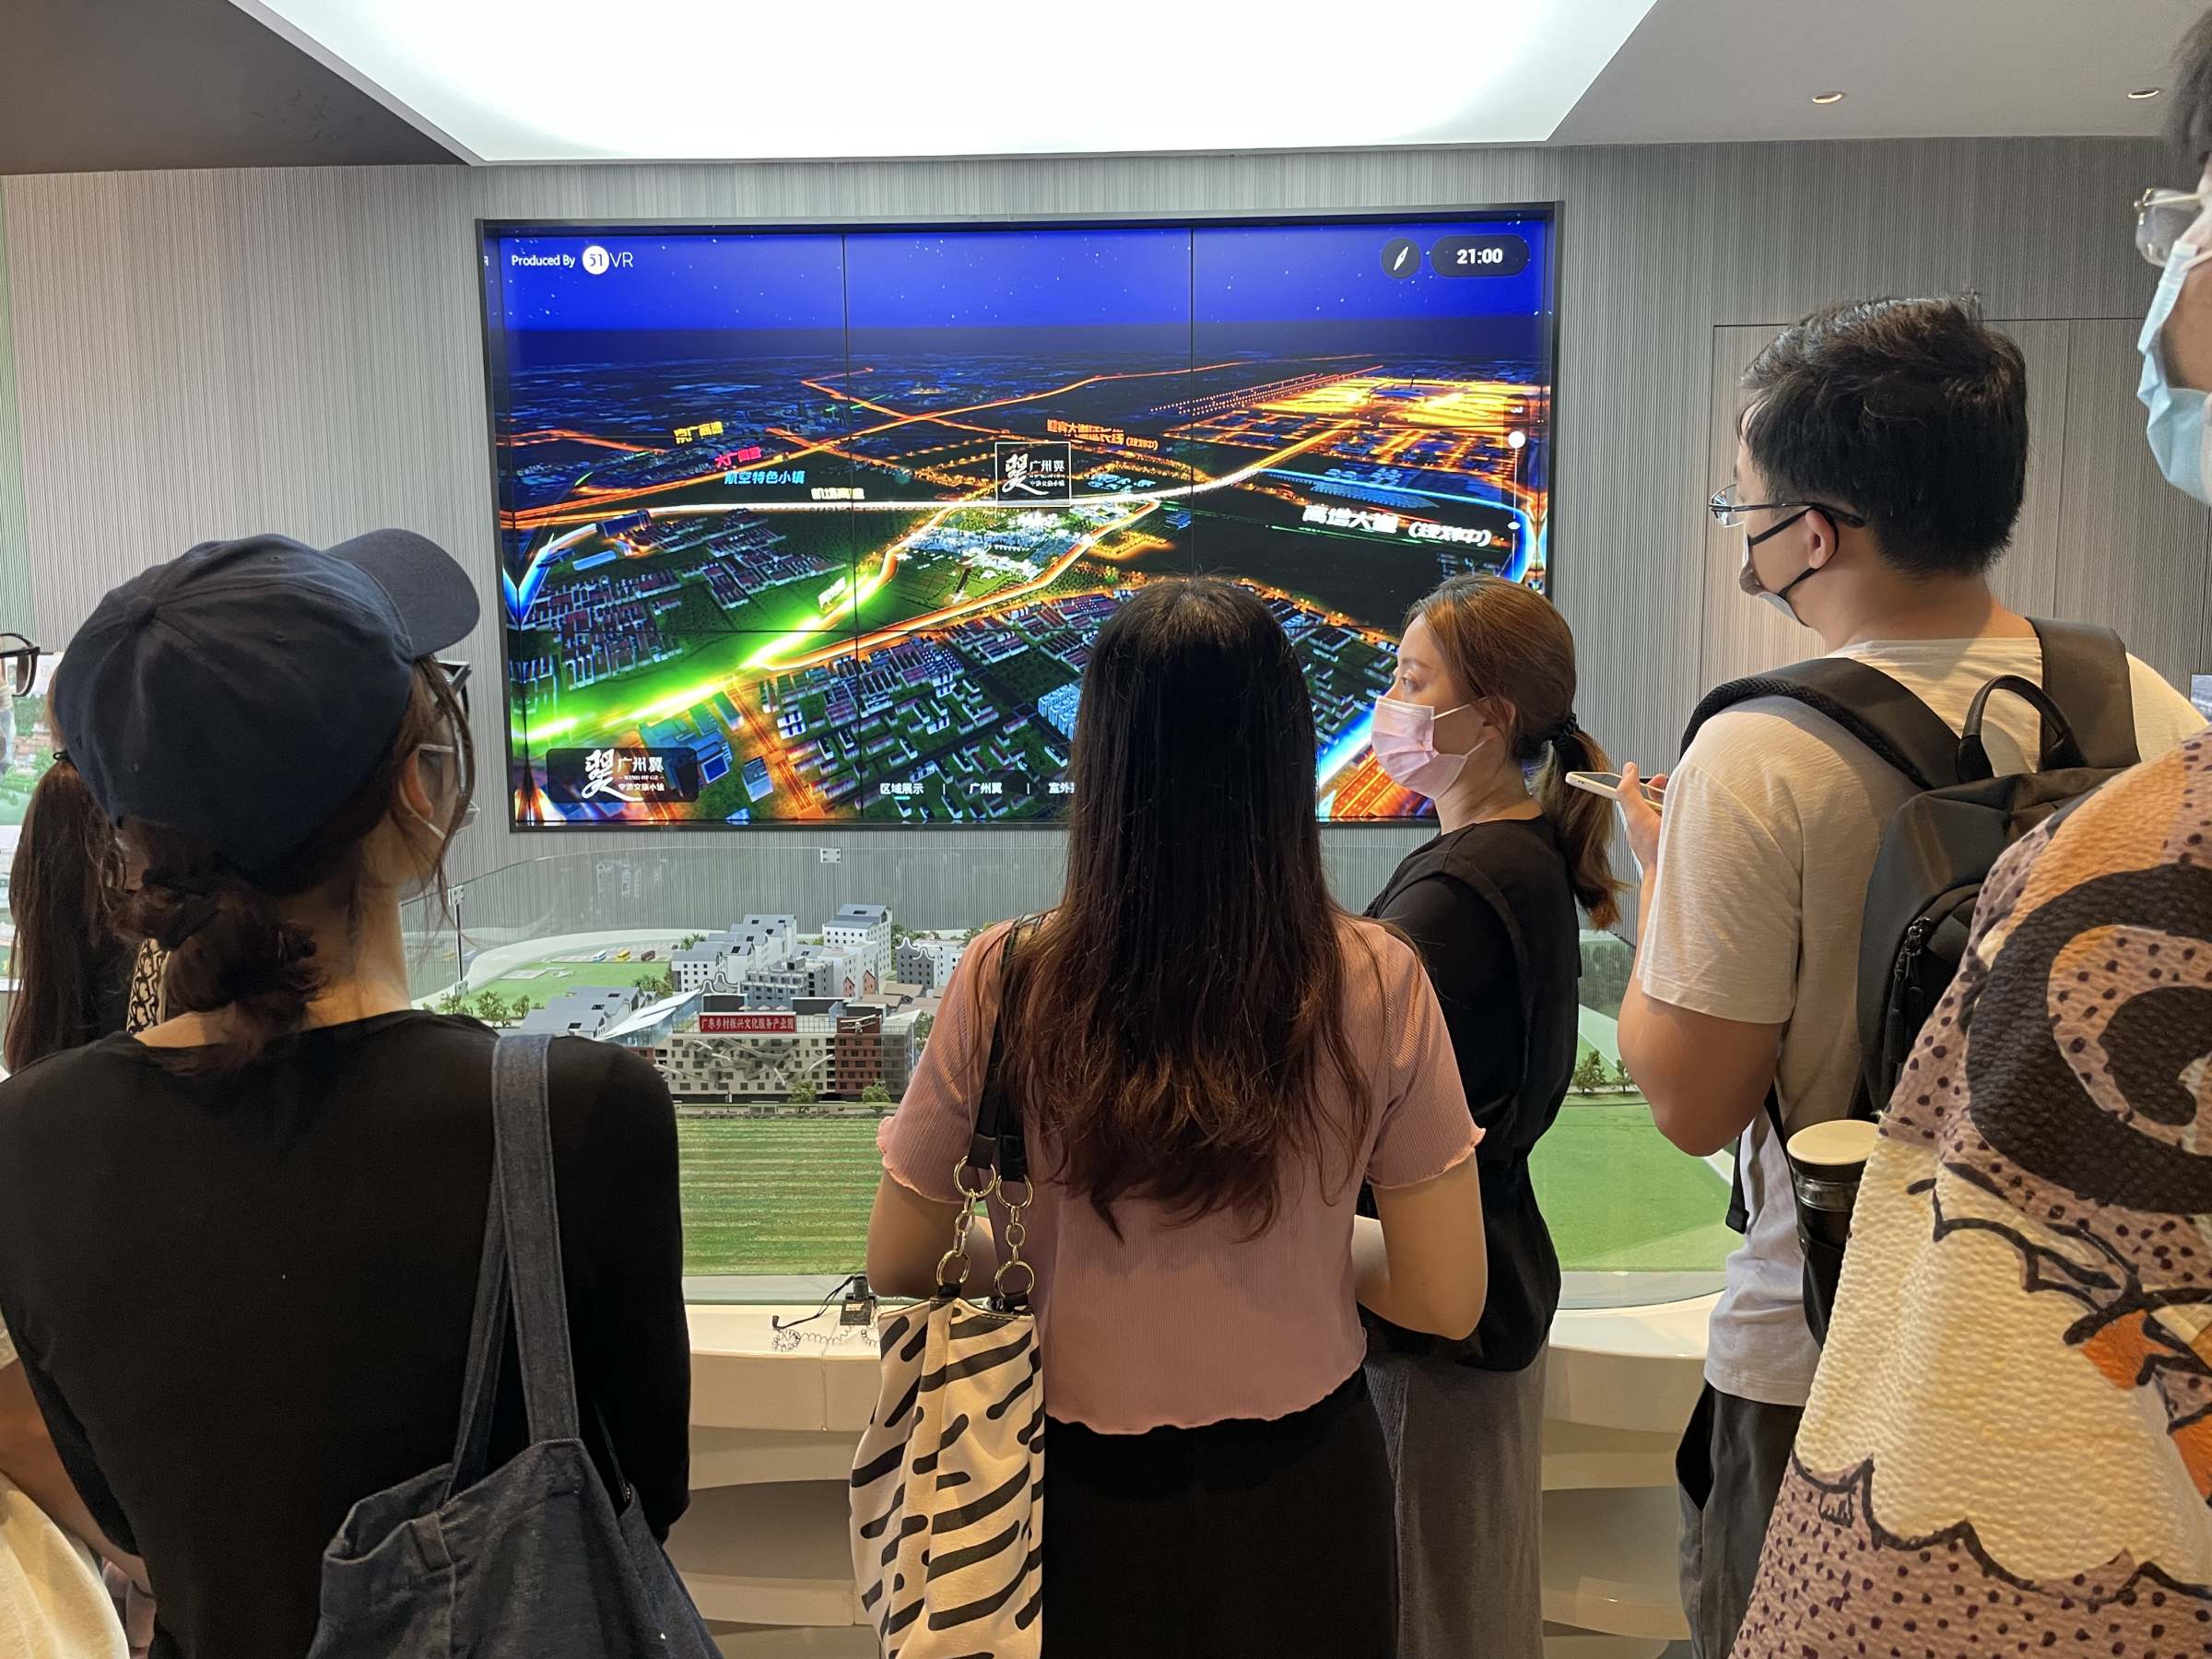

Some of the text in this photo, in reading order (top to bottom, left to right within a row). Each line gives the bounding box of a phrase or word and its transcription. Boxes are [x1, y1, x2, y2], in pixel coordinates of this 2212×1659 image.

[512, 254, 560, 266] Produced
[562, 254, 576, 268] By
[1456, 248, 1503, 265] 21:00
[1029, 459, 1065, 473] 广州翼
[724, 470, 806, 485] 航空特色小镇
[618, 757, 665, 773] 广州翼
[879, 782, 924, 794] 区域展示
[969, 782, 1003, 794] 广州翼
